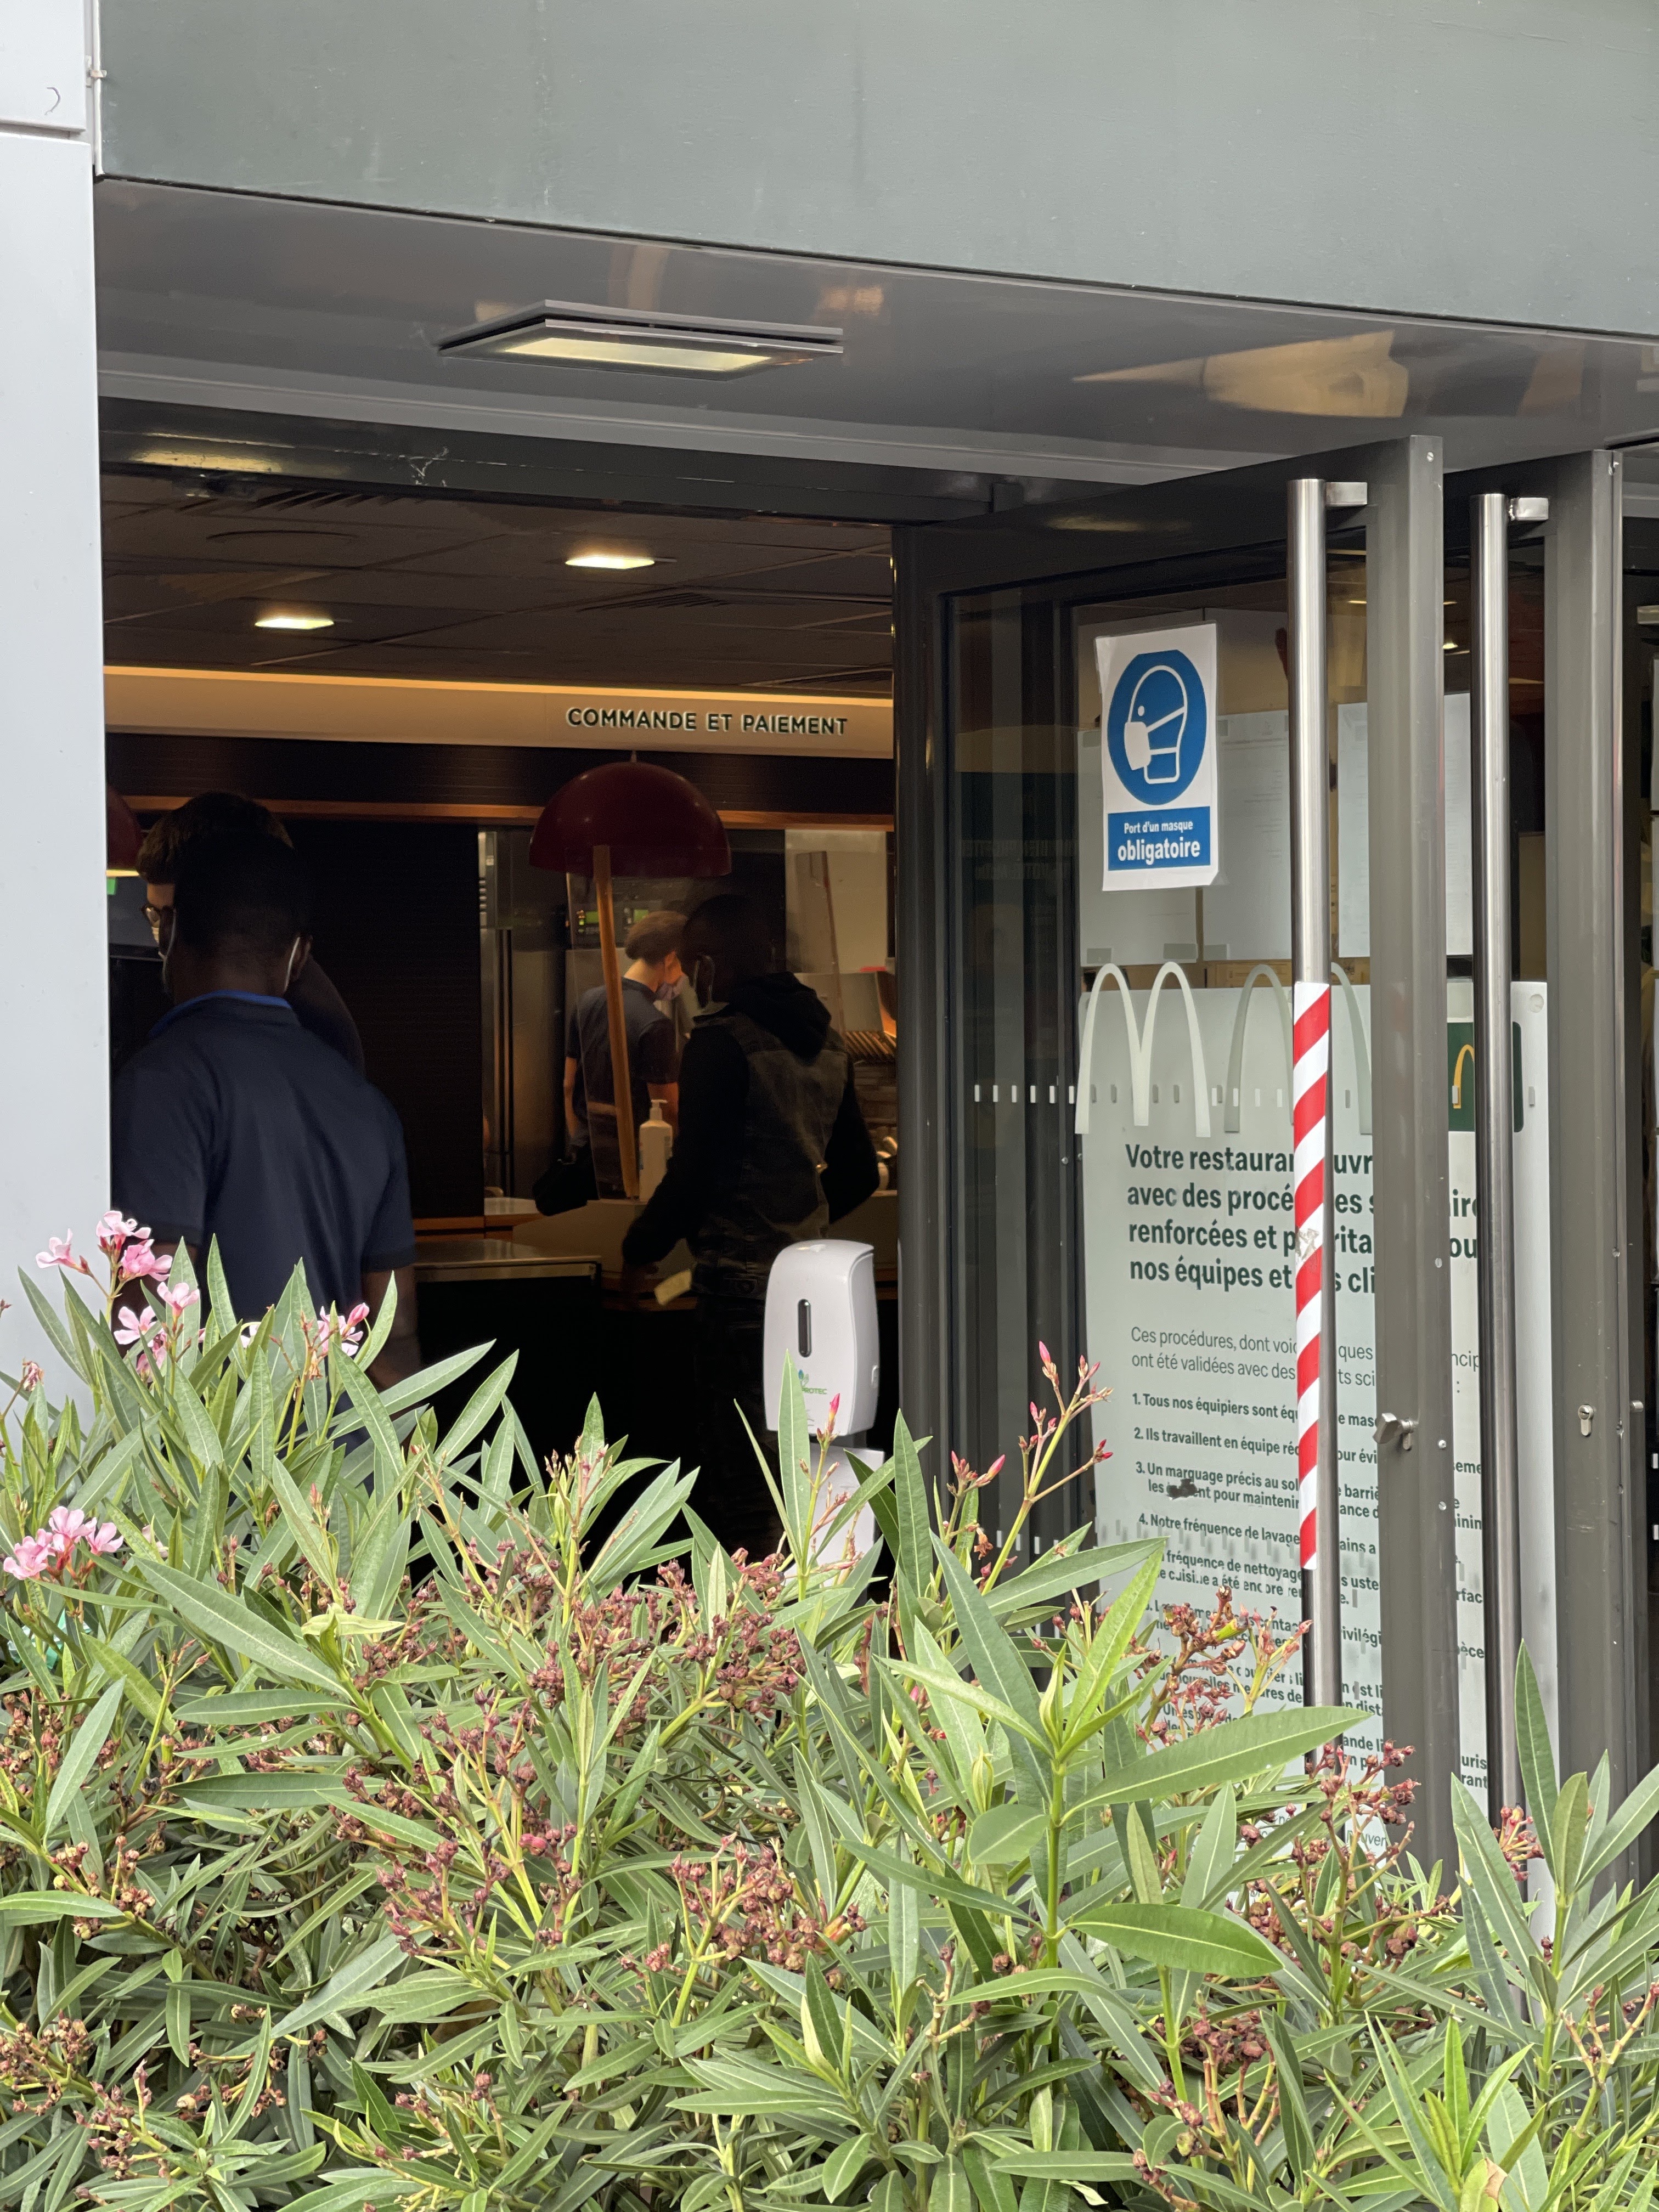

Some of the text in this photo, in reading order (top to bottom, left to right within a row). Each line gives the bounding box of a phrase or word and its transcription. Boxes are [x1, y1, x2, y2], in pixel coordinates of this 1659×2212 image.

[567, 707, 848, 735] COMMANDE ET PAIEMENT
[1124, 821, 1193, 834] Port d'un masque
[1118, 836, 1200, 865] obligatoire
[1125, 1144, 1373, 1175] Votre restaura uvr
[1127, 1186, 1177, 1207] avec
[1182, 1182, 1221, 1208] des
[1129, 1218, 1248, 1248] renforcées
[1254, 1226, 1277, 1250] et
[1130, 1260, 1170, 1281] nos
[1175, 1255, 1263, 1292] équipes
[1269, 1264, 1293, 1289] et
[1131, 1327, 1156, 1342] Ces
[1160, 1329, 1236, 1352] procédures,
[1240, 1334, 1270, 1352] dont
[1132, 1353, 1154, 1367] ont
[1157, 1352, 1178, 1369] été
[1181, 1356, 1234, 1374] validées
[1238, 1363, 1268, 1378] avec
[1272, 1363, 1295, 1380] des
[1132, 1392, 1141, 1405] 1.
[1143, 1393, 1170, 1408] Tous
[1172, 1398, 1193, 1410] nos
[1196, 1397, 1250, 1416] équipiers
[1252, 1405, 1278, 1418] sont
[1134, 1427, 1143, 1440] 2.
[1146, 1427, 1159, 1441] Ils
[1162, 1430, 1222, 1448] travaillent
[1224, 1438, 1238, 1449] en
[1241, 1435, 1280, 1455] équipe
[1136, 1460, 1146, 1474] 3.
[1147, 1462, 1163, 1476] Un
[1165, 1466, 1223, 1486] marquage
[1226, 1470, 1262, 1487] précis
[1265, 1478, 1278, 1488] au
[1282, 1477, 1299, 1491] sol
[1148, 1479, 1164, 1493] les
[1214, 1489, 1240, 1503] pour
[1243, 1491, 1299, 1509] maintenir
[1139, 1513, 1148, 1526] 4.
[1151, 1514, 1181, 1529] Notre
[1183, 1516, 1242, 1537] fréquence
[1245, 1526, 1259, 1540] de
[1262, 1528, 1300, 1547] lavage
[1166, 1550, 1225, 1570] fréquence
[1227, 1559, 1241, 1572] de
[1244, 1563, 1302, 1582] nettoyage
[1212, 1576, 1218, 1587] a
